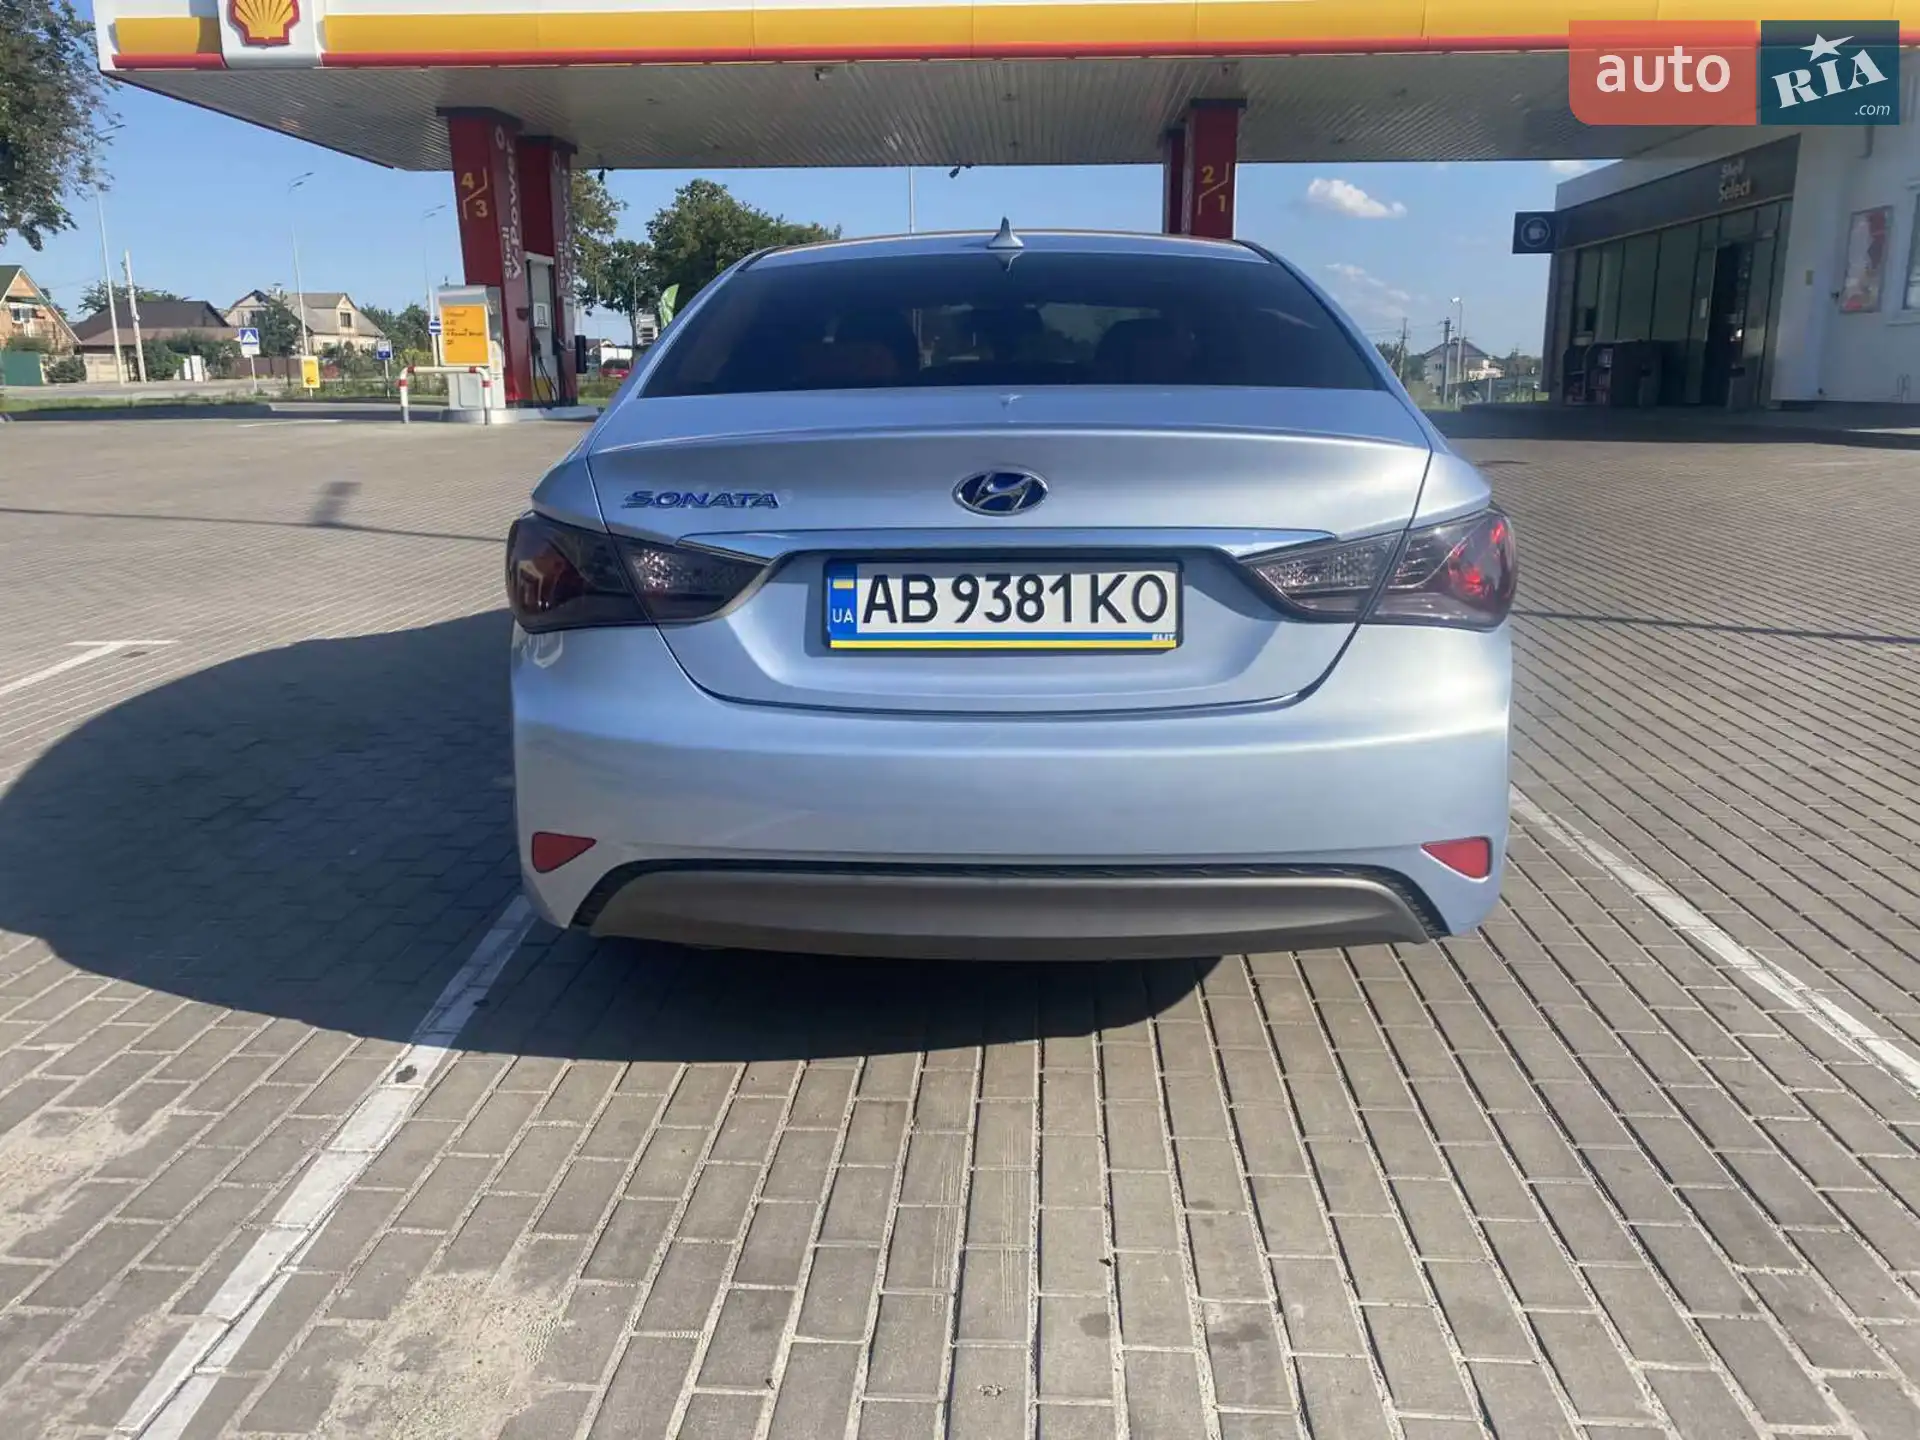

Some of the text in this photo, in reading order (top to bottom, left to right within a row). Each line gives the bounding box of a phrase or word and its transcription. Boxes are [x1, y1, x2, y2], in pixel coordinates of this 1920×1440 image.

[461, 172, 474, 190] 4
[1201, 166, 1215, 183] 2
[1718, 178, 1751, 203] Select
[475, 199, 488, 218] 3
[1218, 195, 1226, 212] 1
[622, 490, 780, 509] SONATA
[862, 572, 1168, 625] AB 9381 KO
[831, 608, 855, 625] UA
